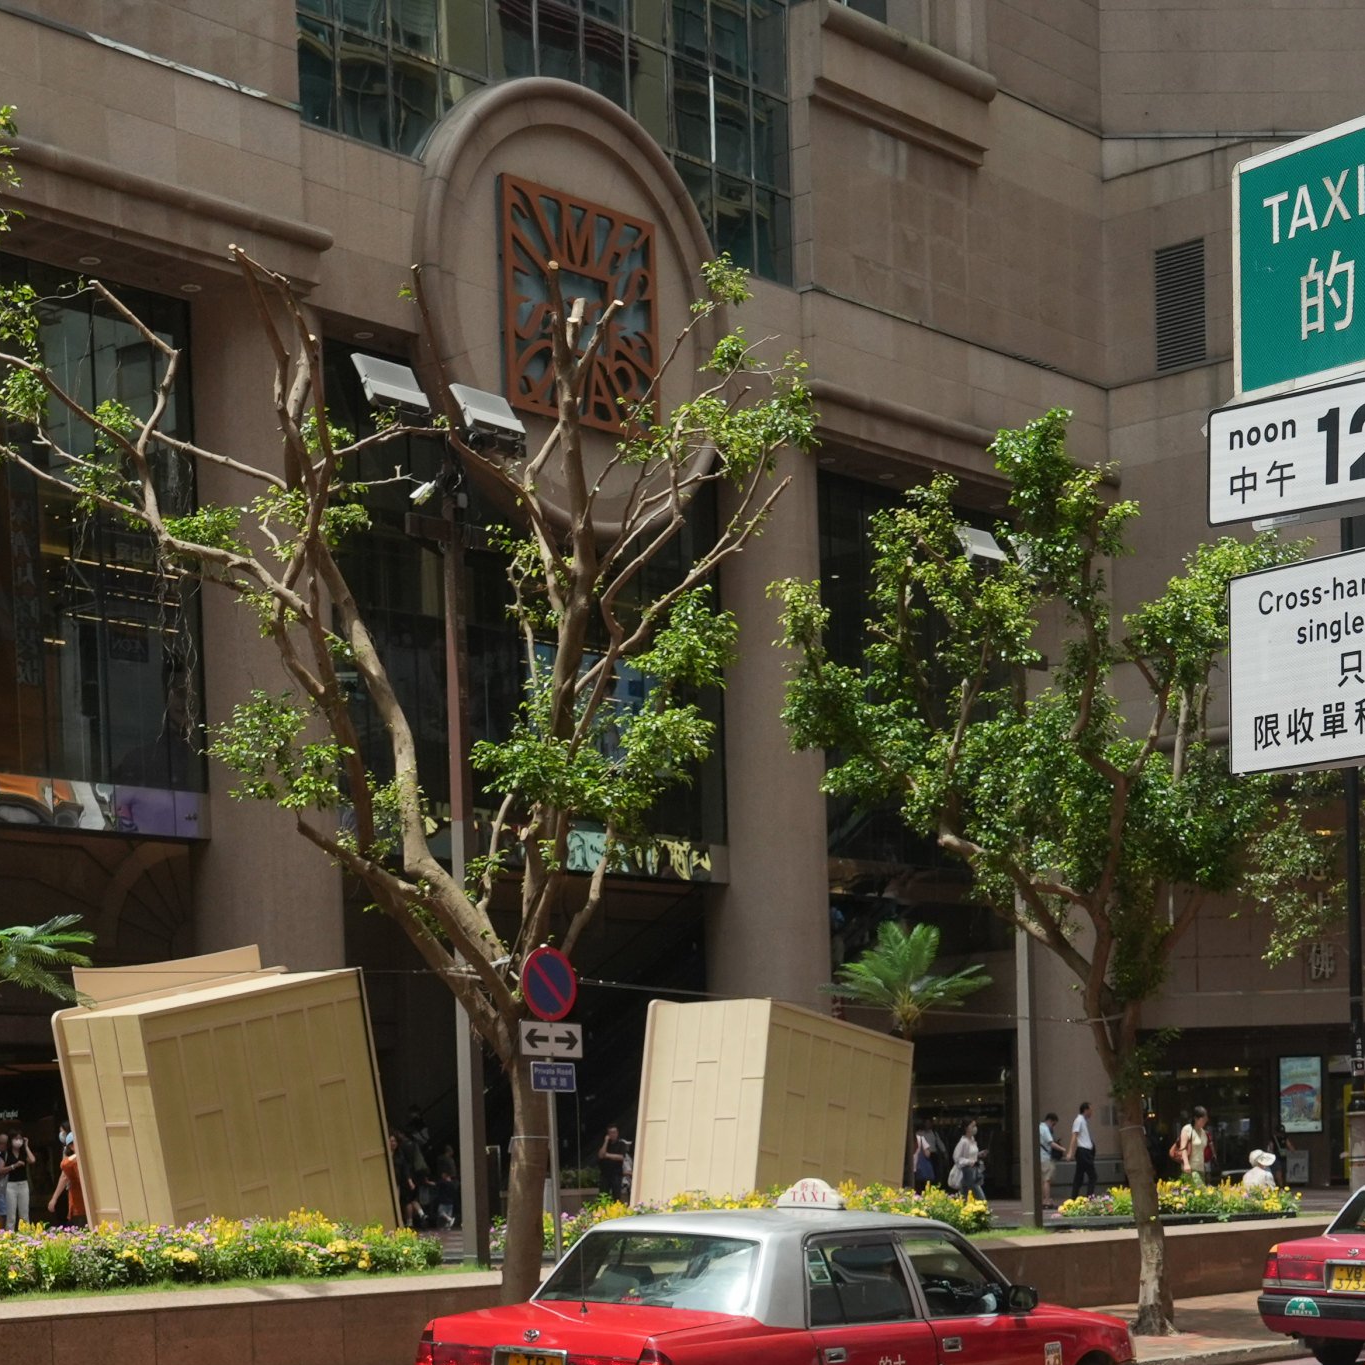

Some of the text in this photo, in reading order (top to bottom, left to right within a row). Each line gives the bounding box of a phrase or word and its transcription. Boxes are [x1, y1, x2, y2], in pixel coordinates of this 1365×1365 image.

[1262, 164, 1365, 244] TAXI
[1229, 418, 1297, 450] noon
[1229, 460, 1296, 504] 中午
[1296, 611, 1365, 645] single
[790, 1190, 827, 1203] TAXI
[1346, 1266, 1363, 1279] VB
